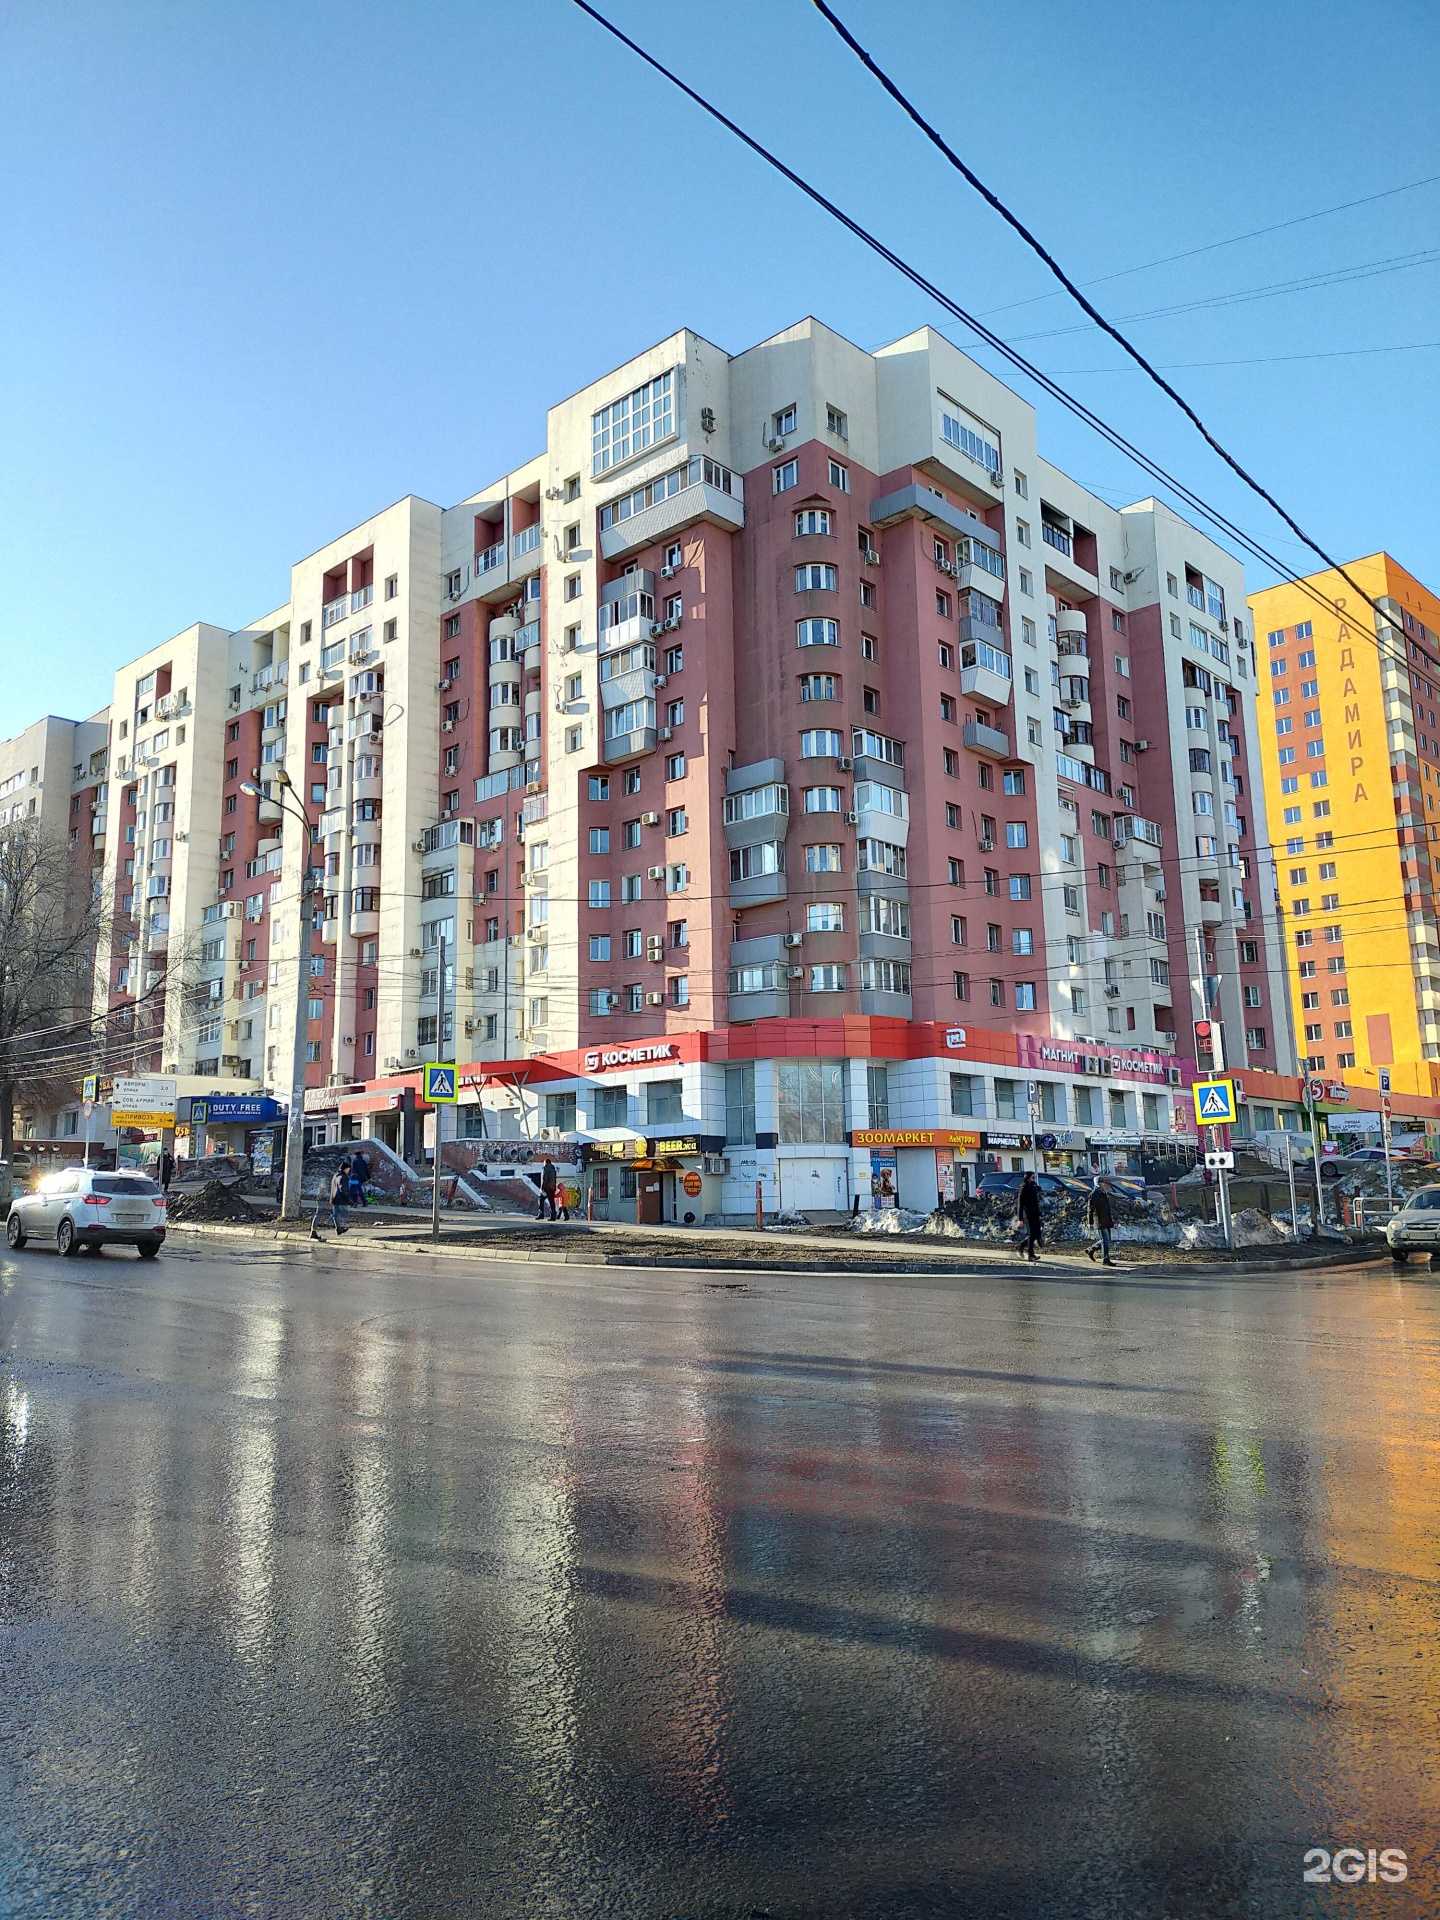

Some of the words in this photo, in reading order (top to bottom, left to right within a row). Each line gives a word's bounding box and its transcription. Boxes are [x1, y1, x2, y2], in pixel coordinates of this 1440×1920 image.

[1334, 598, 1369, 803] РАДАМИРА
[602, 1044, 673, 1066] КОСМЕТИК
[1042, 1047, 1079, 1063] МАГНИТ
[1121, 1060, 1163, 1075] КОСМЕТИК
[857, 1132, 935, 1144] ЗООМАРКЕТ
